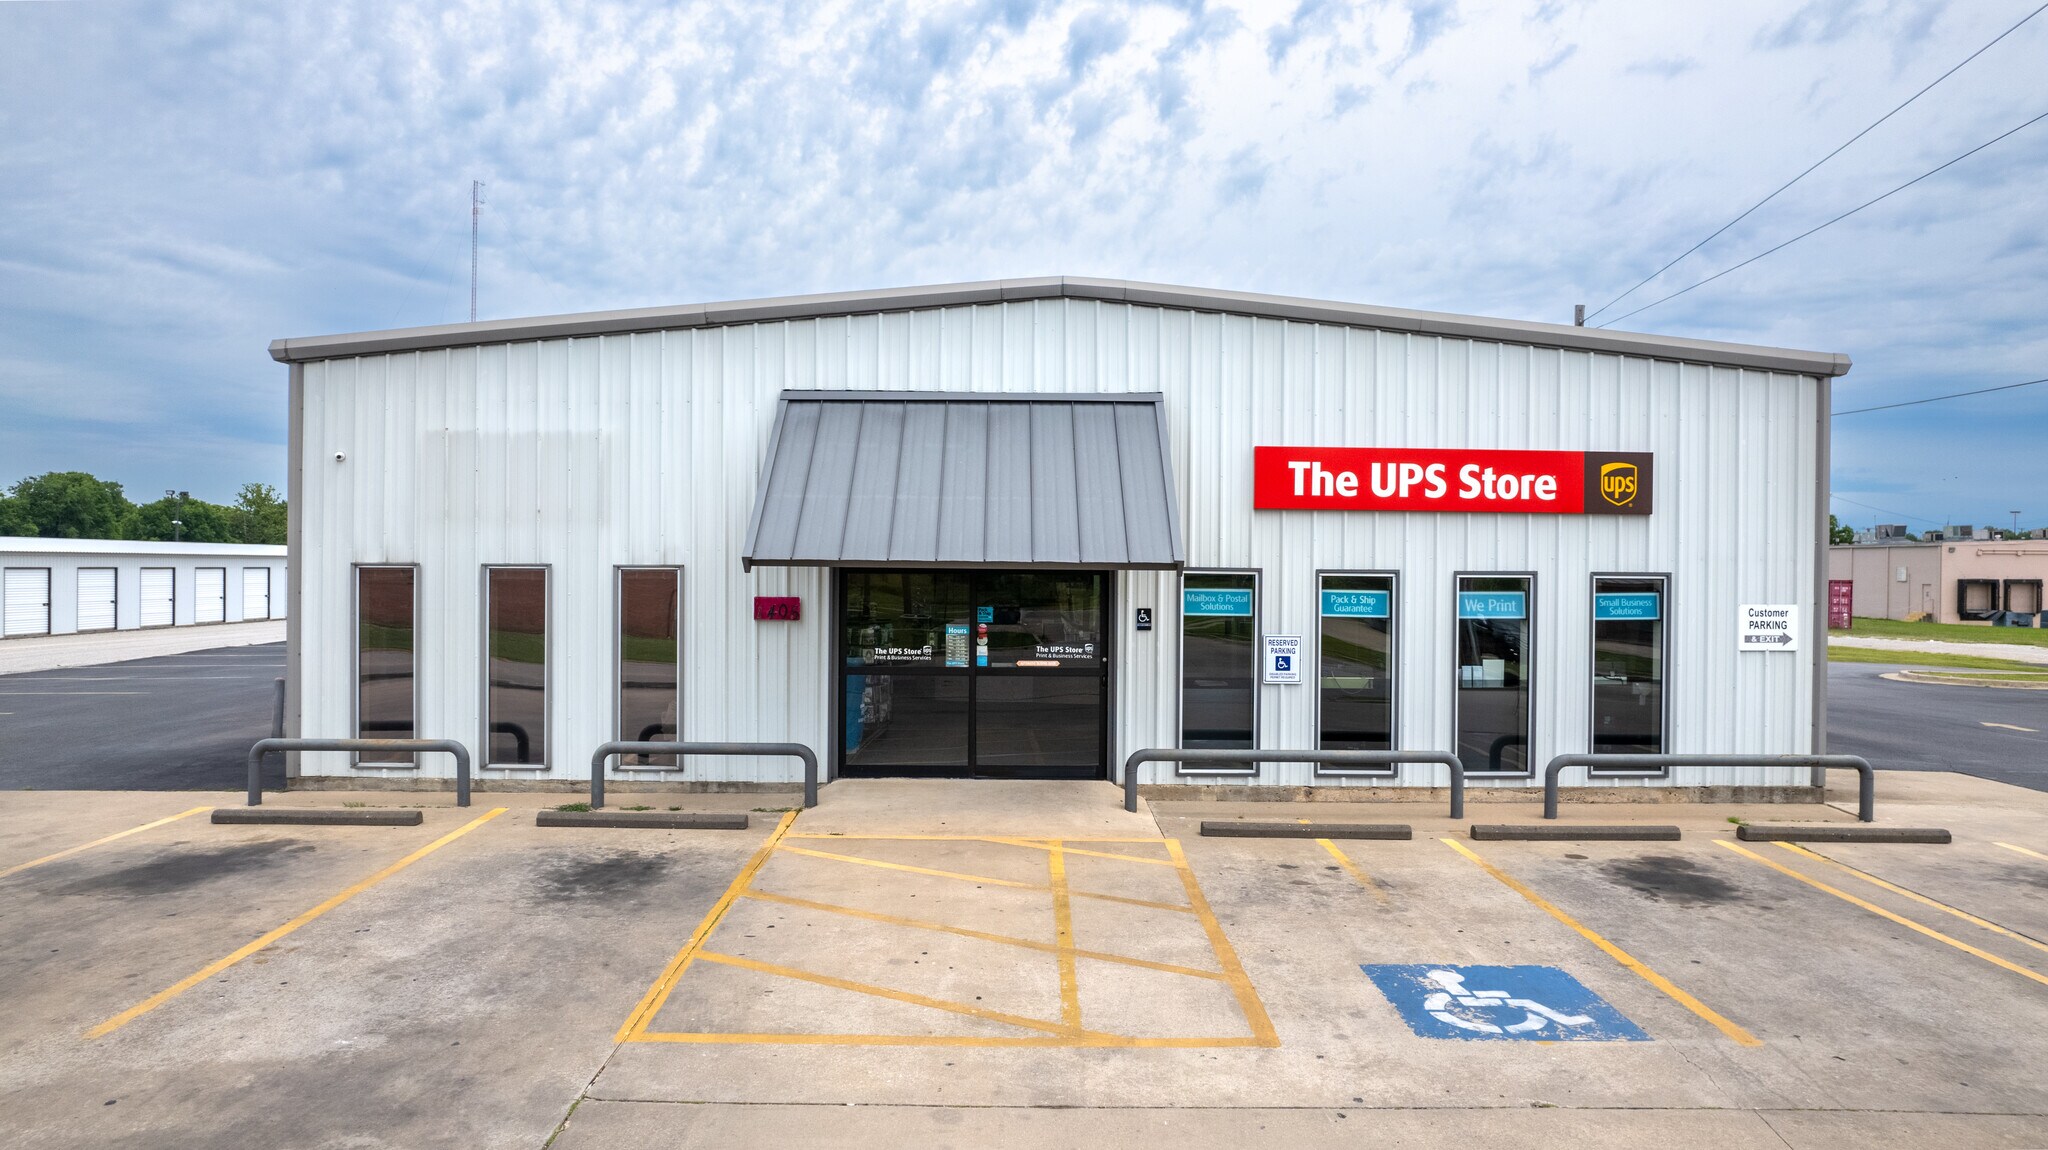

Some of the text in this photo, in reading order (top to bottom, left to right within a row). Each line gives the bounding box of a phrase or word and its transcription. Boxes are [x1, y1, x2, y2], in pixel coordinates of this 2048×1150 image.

[1288, 461, 1557, 500] The UPS Store
[1604, 476, 1634, 498] ups
[1187, 594, 1248, 602] Mailbox & Postal
[1331, 595, 1376, 606] Pack & Ship
[1600, 598, 1652, 606] Small Business
[1200, 602, 1234, 610] Solutions
[1334, 604, 1373, 612] Guarantee
[1465, 599, 1516, 611] We Print
[1610, 607, 1642, 615] Solutions
[1748, 608, 1789, 617] Customer
[1749, 620, 1788, 630] PARKING
[1760, 635, 1780, 643] EXIT
[875, 647, 922, 655] The UPS Store
[1036, 645, 1049, 653] The
